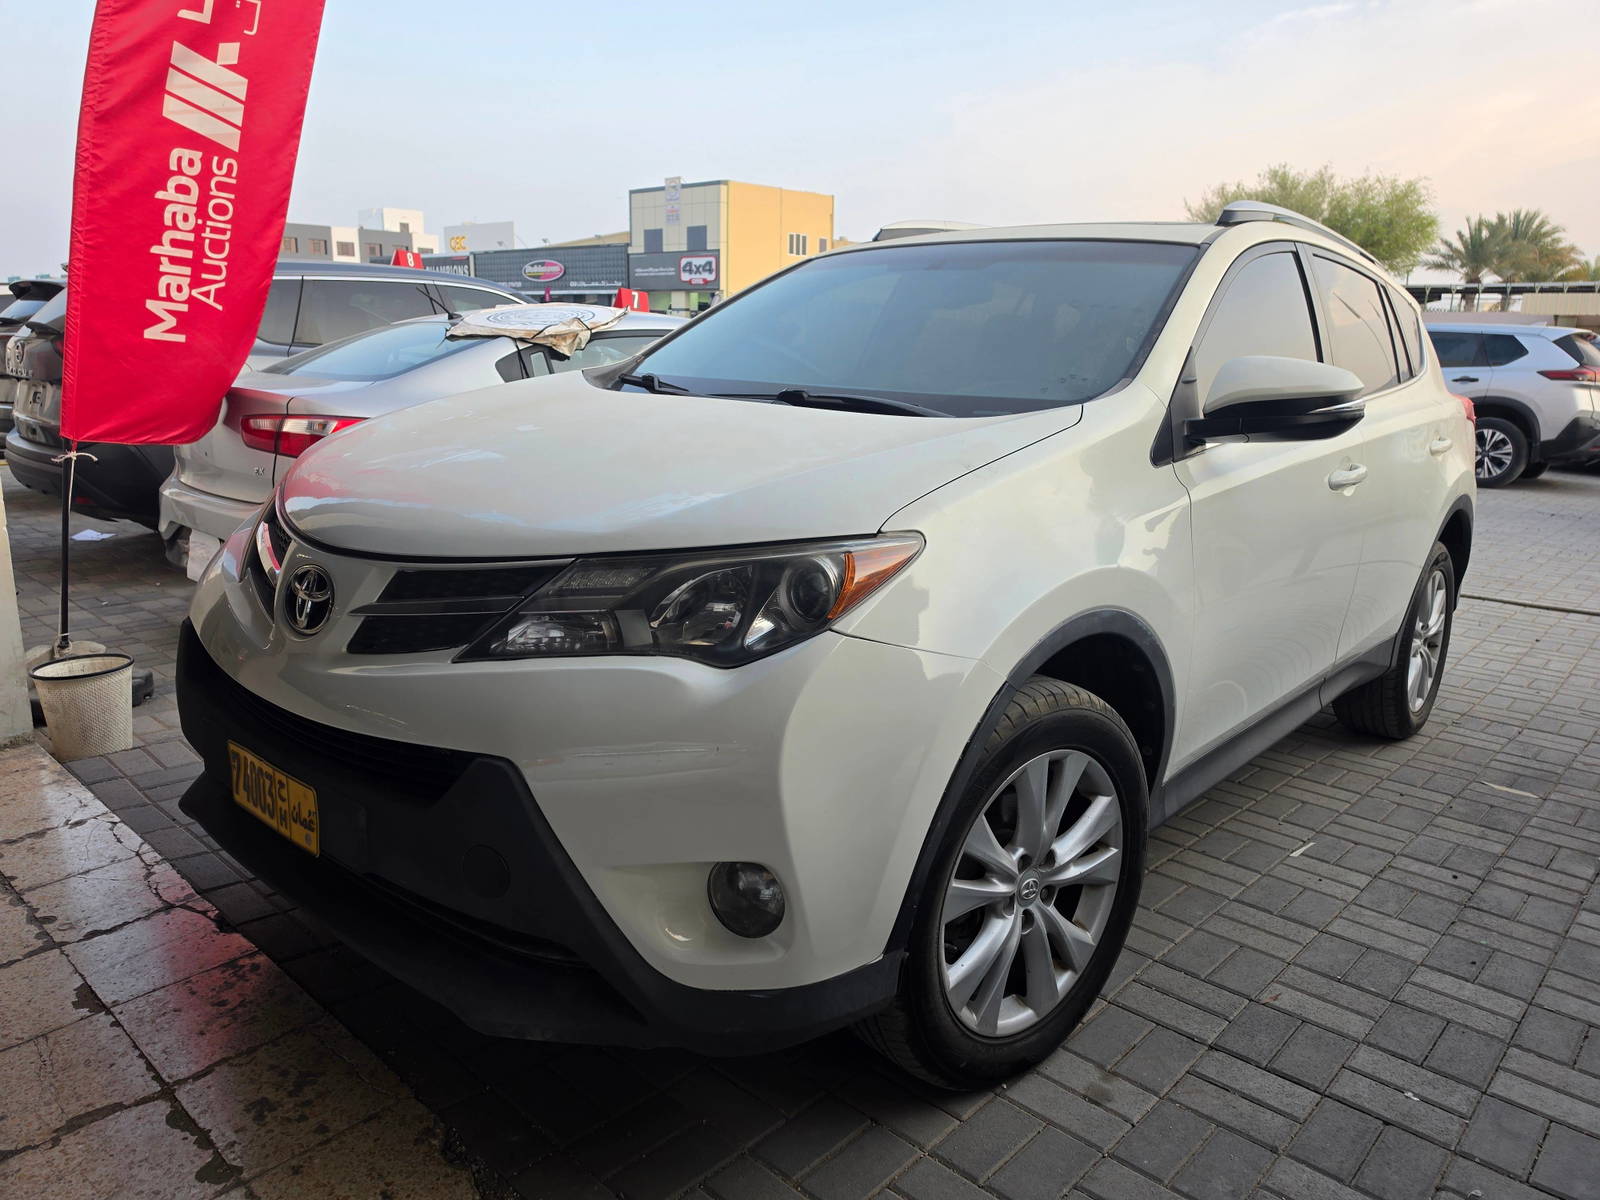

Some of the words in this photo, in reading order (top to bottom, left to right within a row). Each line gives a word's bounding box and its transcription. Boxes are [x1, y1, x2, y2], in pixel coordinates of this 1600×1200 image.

[144, 147, 203, 343] Marhaba
[191, 156, 238, 311] Auctions
[406, 252, 415, 268] 8
[682, 261, 714, 275] 4x4
[632, 291, 640, 309] 7
[230, 750, 275, 820] 74003
